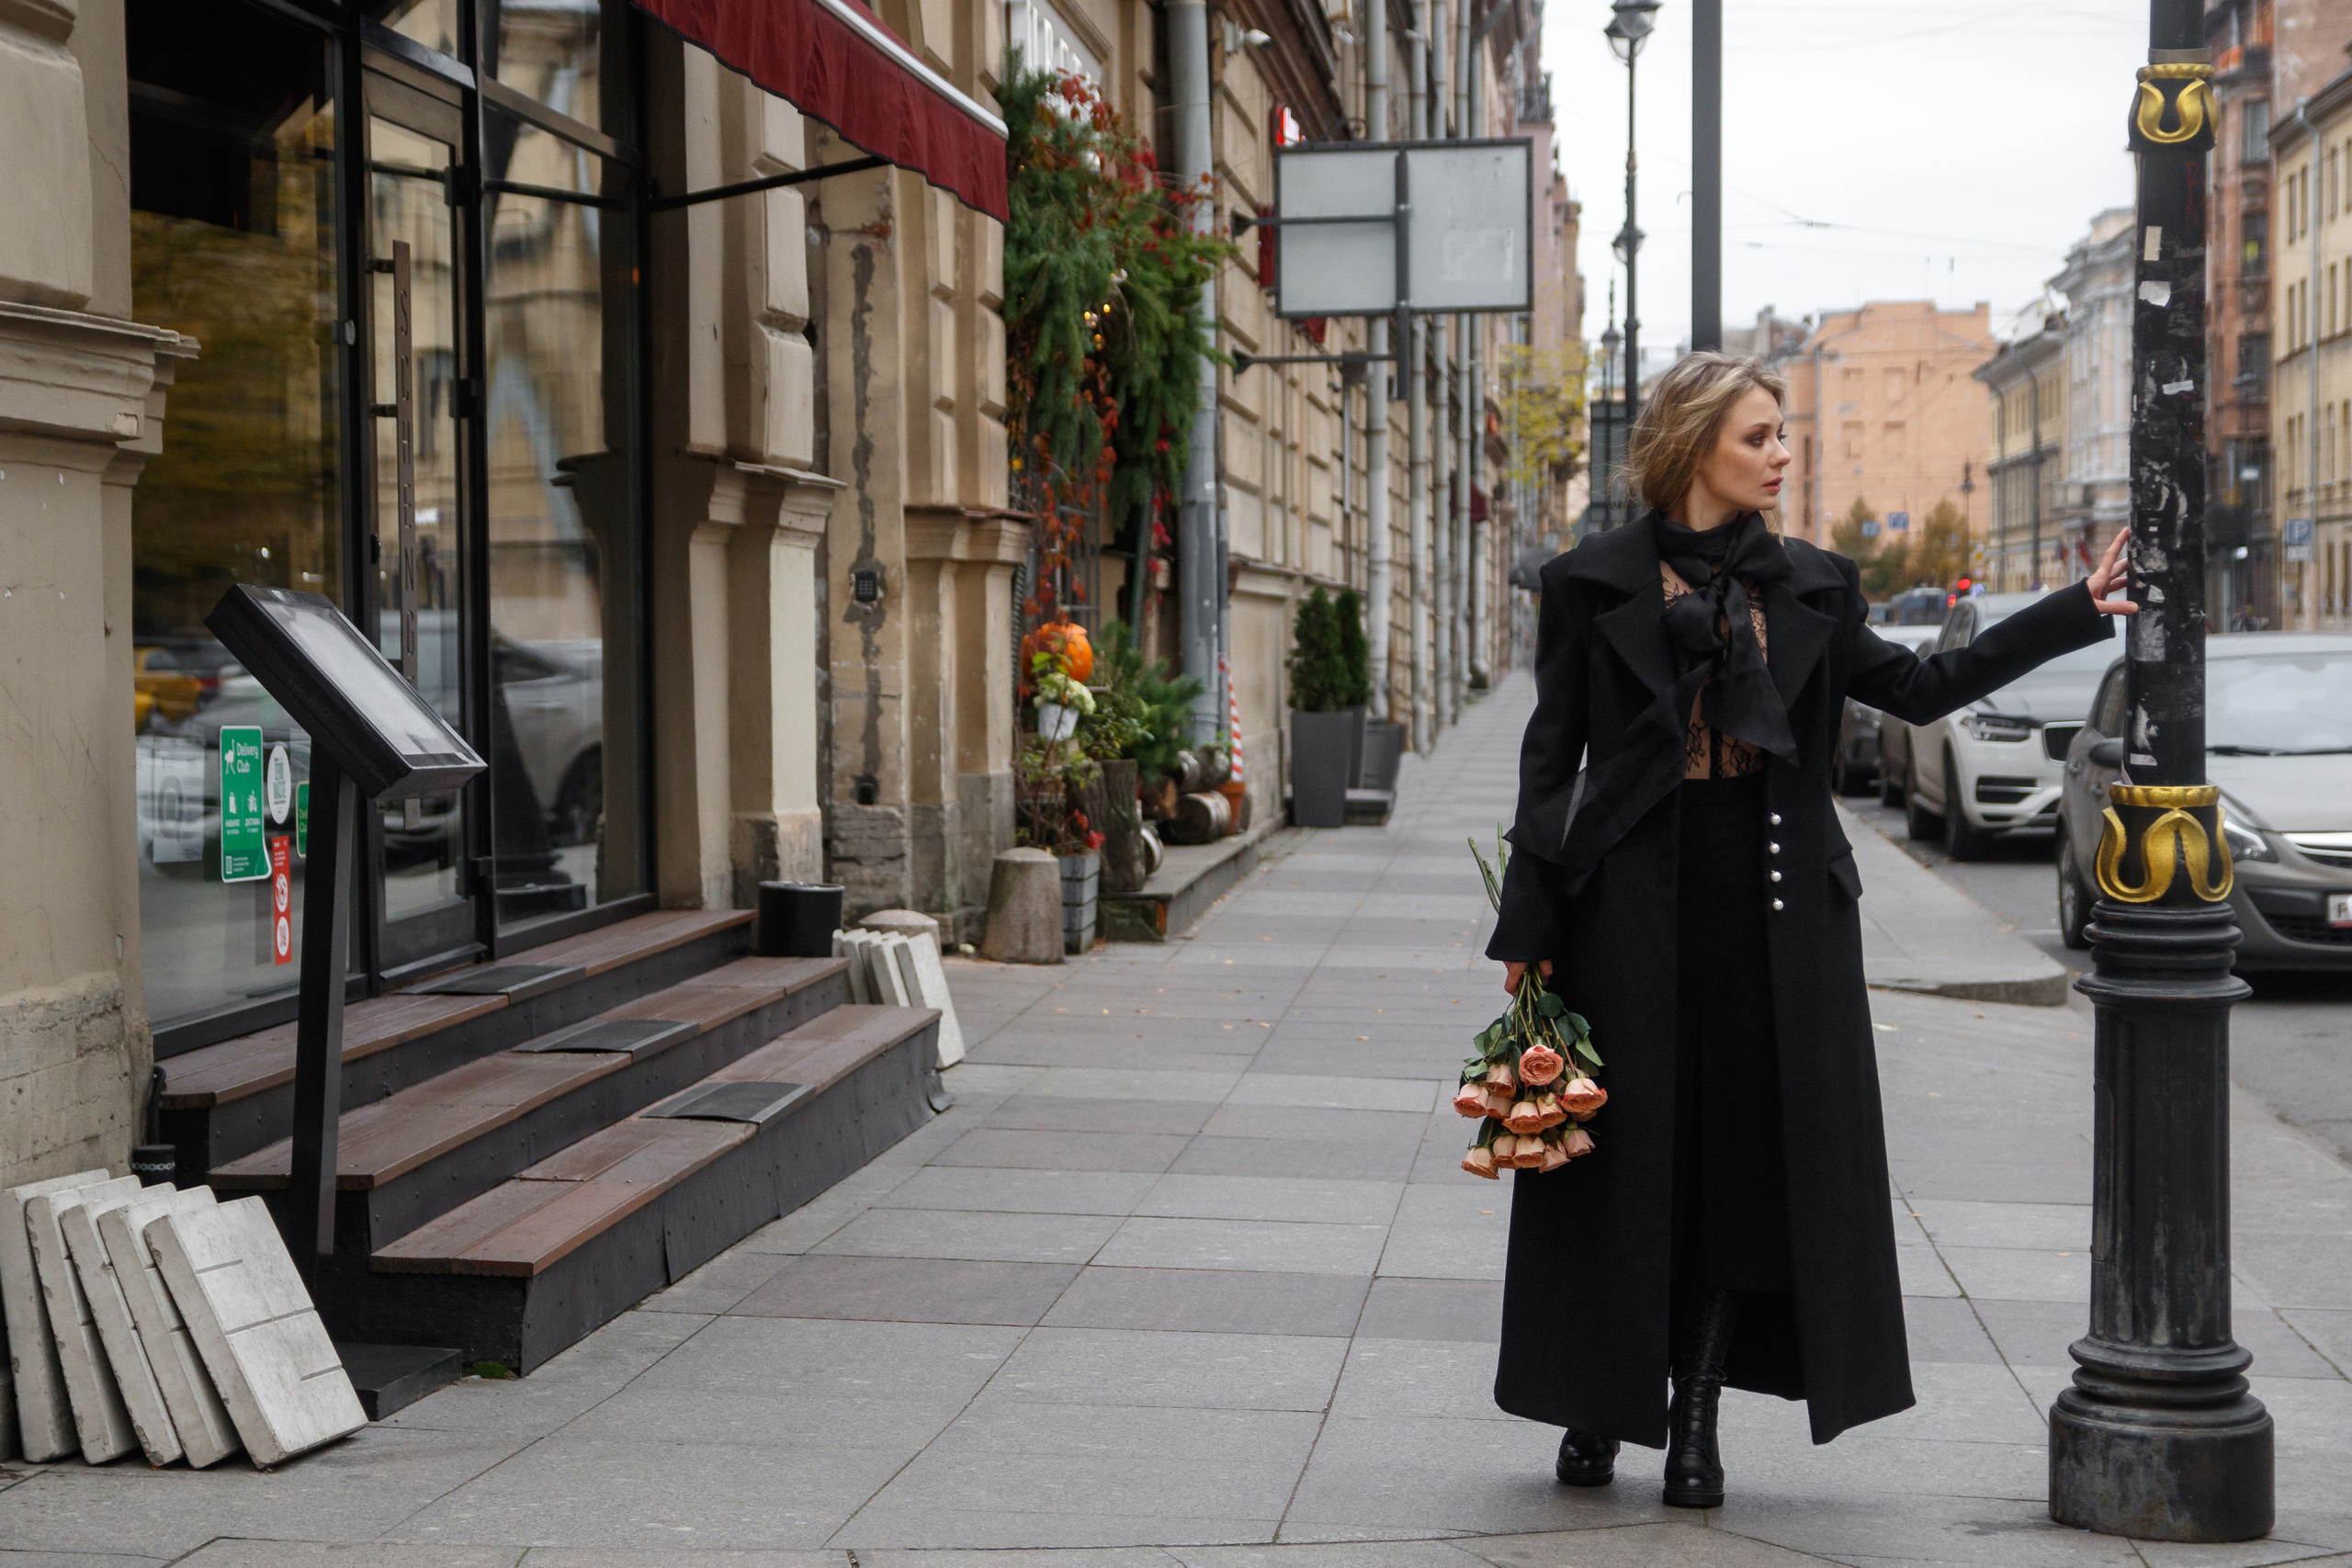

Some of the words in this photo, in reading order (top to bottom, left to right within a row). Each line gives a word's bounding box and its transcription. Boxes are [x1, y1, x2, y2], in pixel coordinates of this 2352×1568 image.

[400, 289, 415, 682] SCHENG
[2294, 521, 2309, 539] P
[237, 743, 258, 759] Delivery
[237, 760, 250, 773] Club
